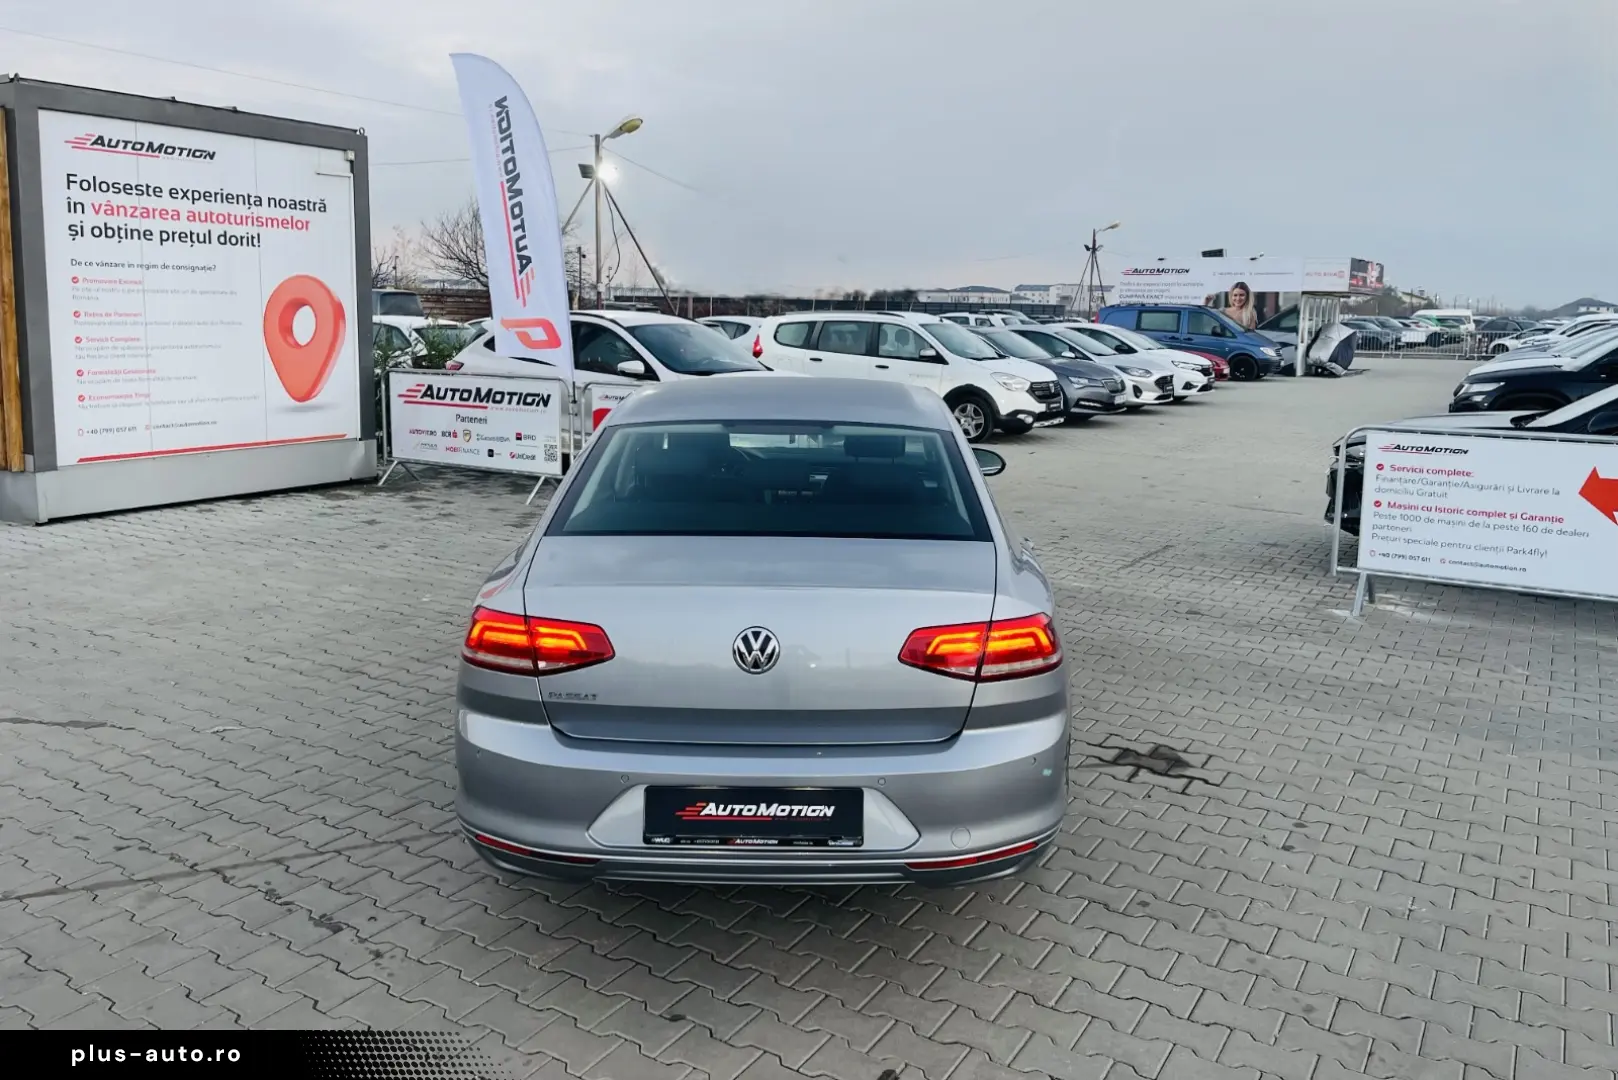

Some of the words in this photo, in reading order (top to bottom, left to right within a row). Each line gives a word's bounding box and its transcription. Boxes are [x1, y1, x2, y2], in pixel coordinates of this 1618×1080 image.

[66, 173, 163, 198] Foloseste
[168, 187, 263, 209] experiența
[267, 194, 327, 213] noastră
[66, 197, 86, 215] în
[91, 200, 181, 222] vânzarea
[186, 208, 310, 232] autoturismelor
[67, 222, 84, 242] și
[90, 222, 153, 243] obține
[159, 229, 212, 249] prețul
[216, 230, 261, 248] dorit!
[70, 258, 83, 267] De
[136, 263, 159, 271] regim
[419, 383, 551, 408] AUTOMOTION
[455, 413, 488, 425] Parteneri
[1390, 464, 1424, 474] Servicii
[1374, 486, 1414, 497] domiciliu
[1416, 488, 1448, 499] Gratuit
[1517, 484, 1549, 495] Livrare
[1552, 486, 1560, 496] la
[1421, 504, 1433, 513] cu
[1435, 504, 1465, 515] Istoric
[1467, 507, 1507, 519] complet
[1520, 512, 1564, 525] Garanție
[1371, 523, 1413, 533] parteneri
[1373, 511, 1398, 520] Peste
[1399, 512, 1422, 523] 1000
[1424, 513, 1435, 524] de
[1468, 518, 1480, 528] de
[1482, 520, 1491, 529] la
[1493, 522, 1520, 533] peste
[1522, 523, 1538, 533] 160
[1540, 524, 1554, 535] de
[1556, 526, 1590, 538] dealeri
[1403, 536, 1439, 549] speciale
[1440, 540, 1472, 551] pentru
[1507, 546, 1548, 559] Park4fly!
[699, 802, 836, 817] AUTOMOTION
